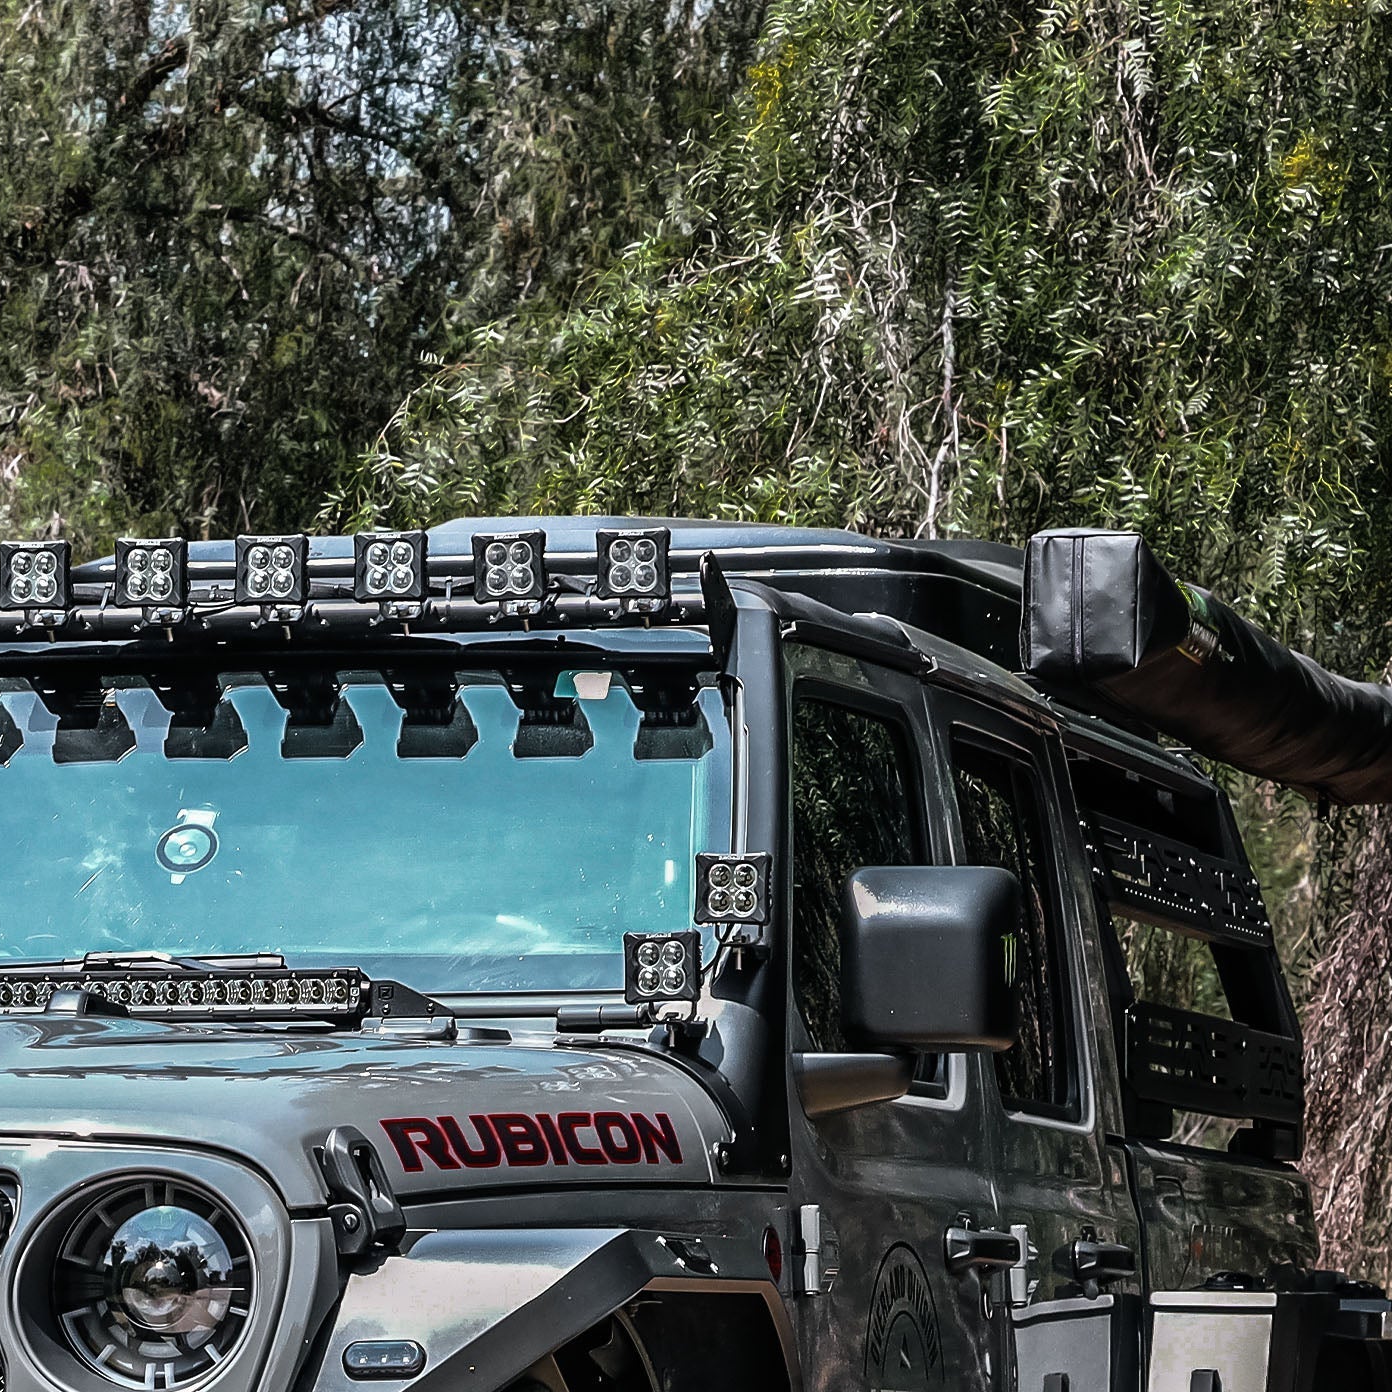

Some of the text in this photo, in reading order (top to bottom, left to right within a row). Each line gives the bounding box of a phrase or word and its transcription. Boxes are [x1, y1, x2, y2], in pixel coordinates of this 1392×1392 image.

[379, 1112, 683, 1172] RUBICON
[870, 1263, 939, 1369] OVERLAND DIVISION
